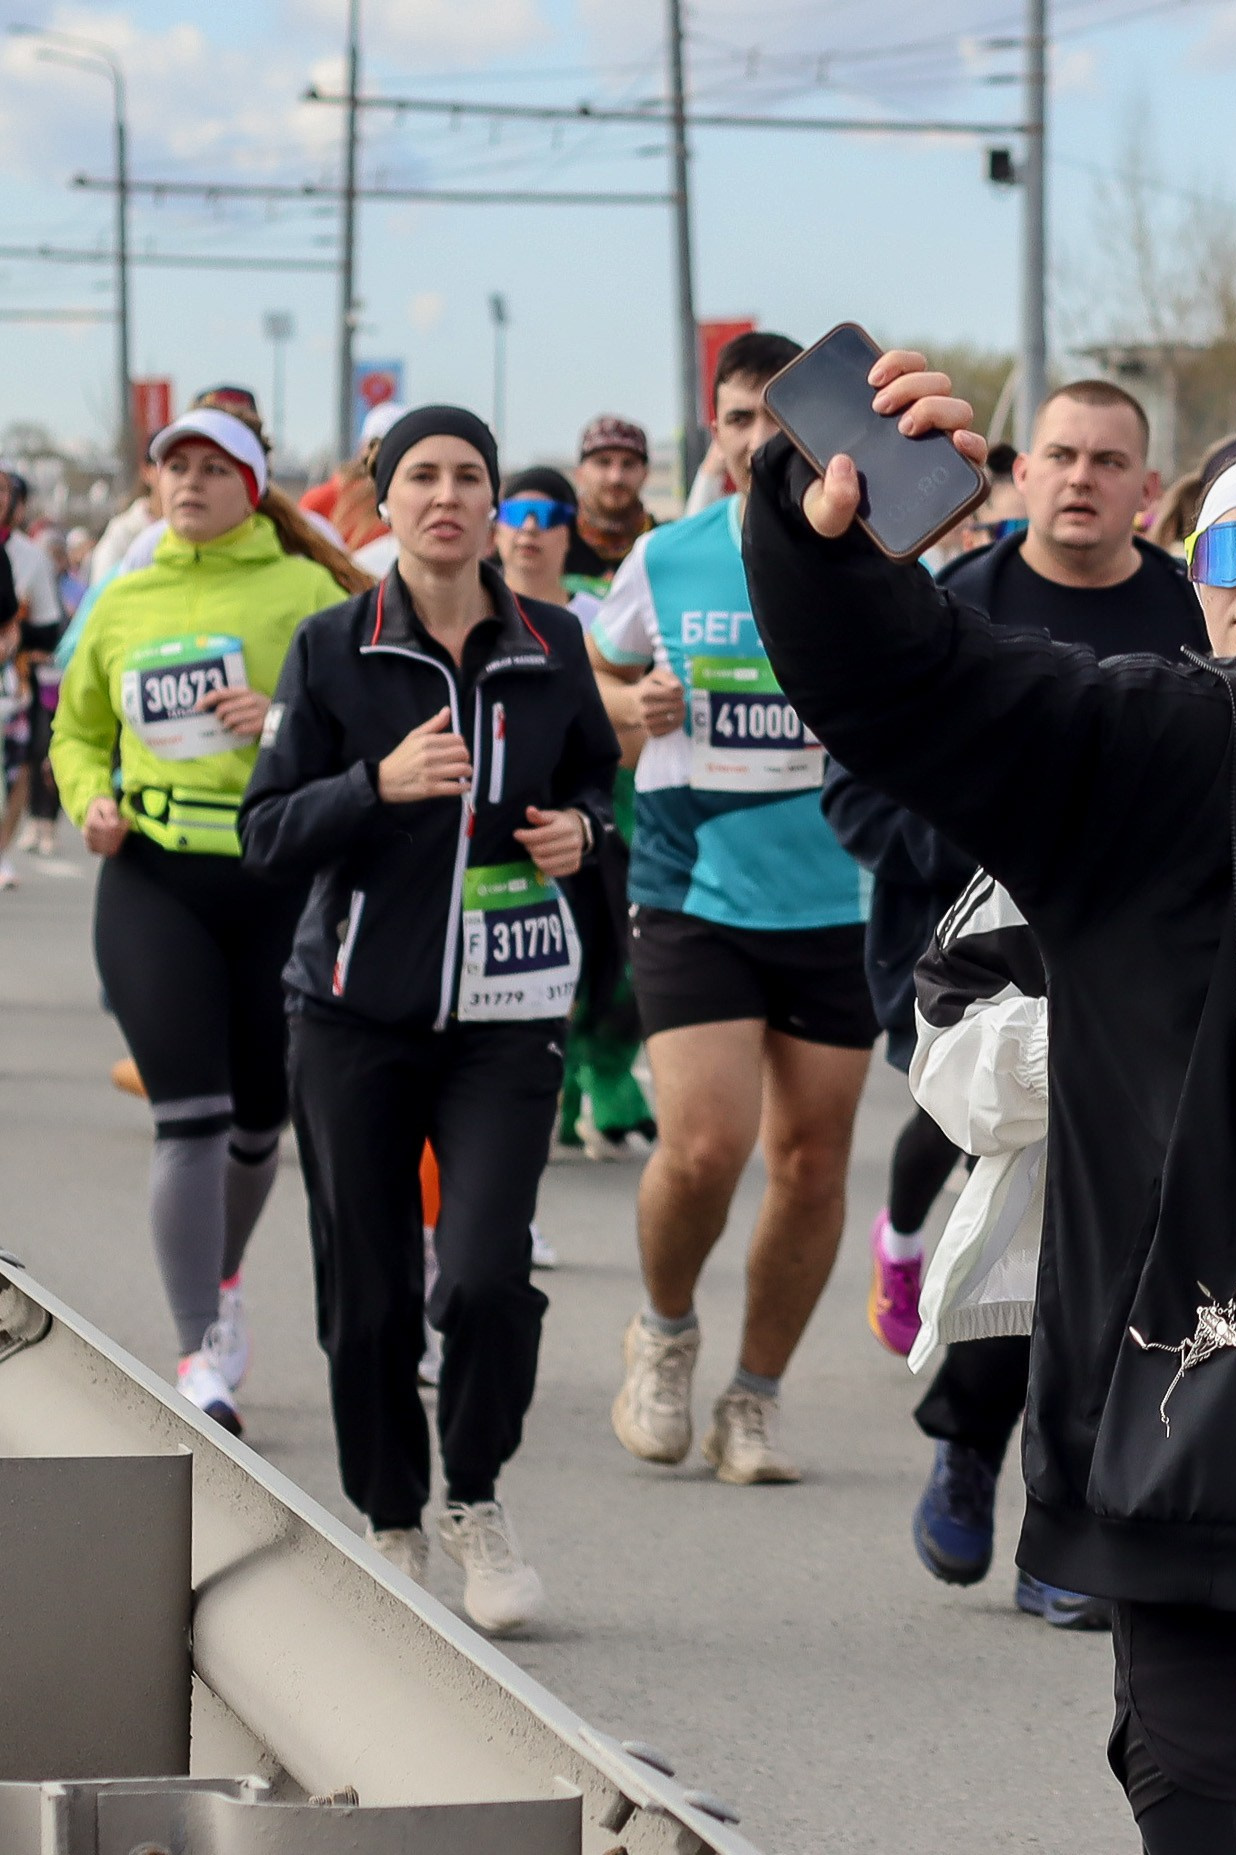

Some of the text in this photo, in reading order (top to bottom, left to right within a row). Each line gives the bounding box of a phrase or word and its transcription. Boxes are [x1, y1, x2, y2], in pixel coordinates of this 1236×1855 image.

[682, 611, 763, 645] БЕГ
[715, 703, 798, 739] 41000
[469, 933, 481, 953] F
[493, 914, 563, 963] 31779
[470, 990, 524, 1006] 31779
